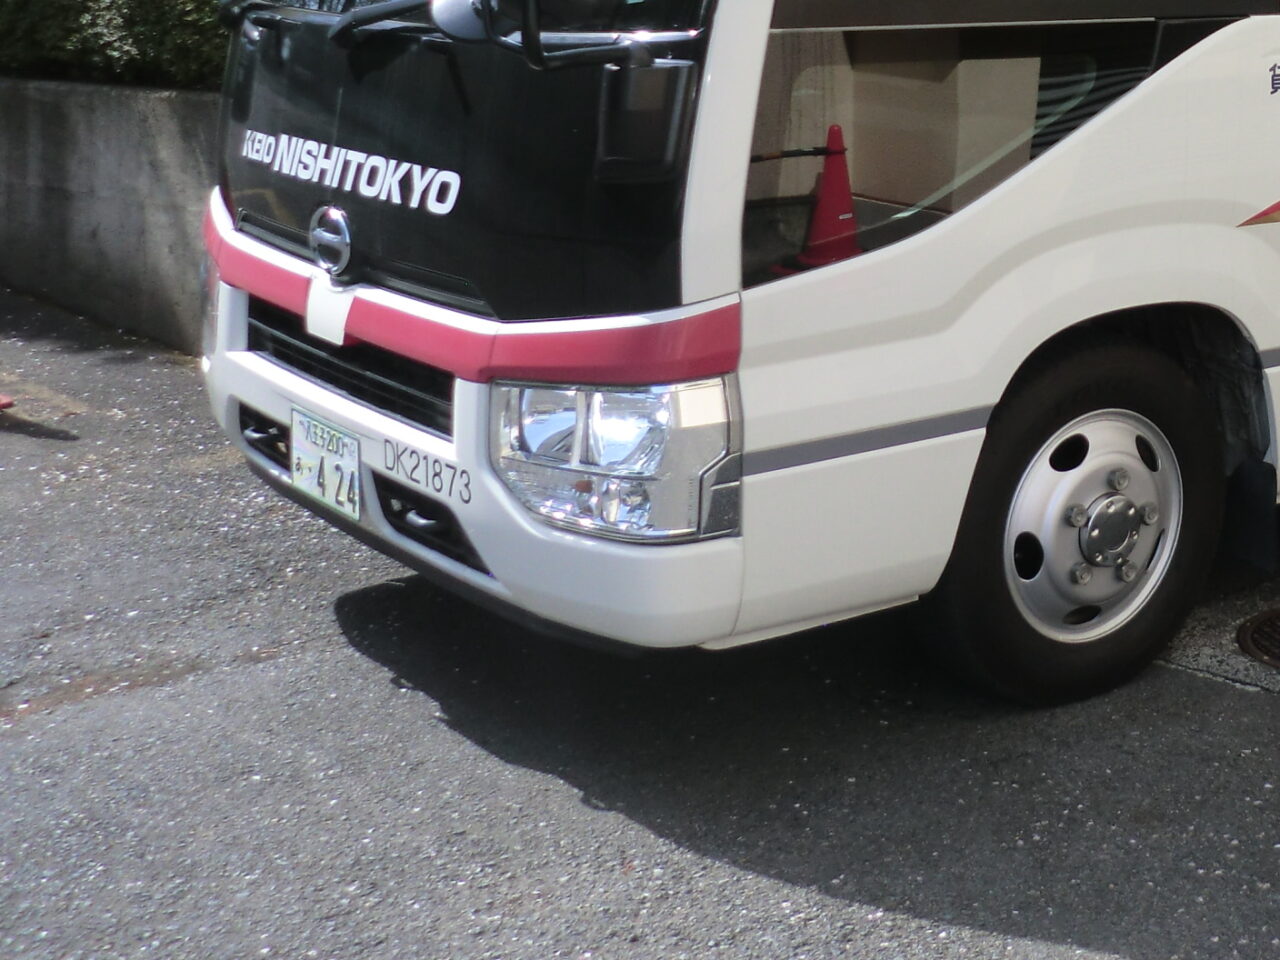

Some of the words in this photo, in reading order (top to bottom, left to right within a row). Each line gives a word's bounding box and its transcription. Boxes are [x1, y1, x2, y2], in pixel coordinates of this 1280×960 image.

[242, 130, 276, 163] KEIO
[273, 134, 461, 215] NISHITOKYO
[384, 438, 472, 505] DK21873
